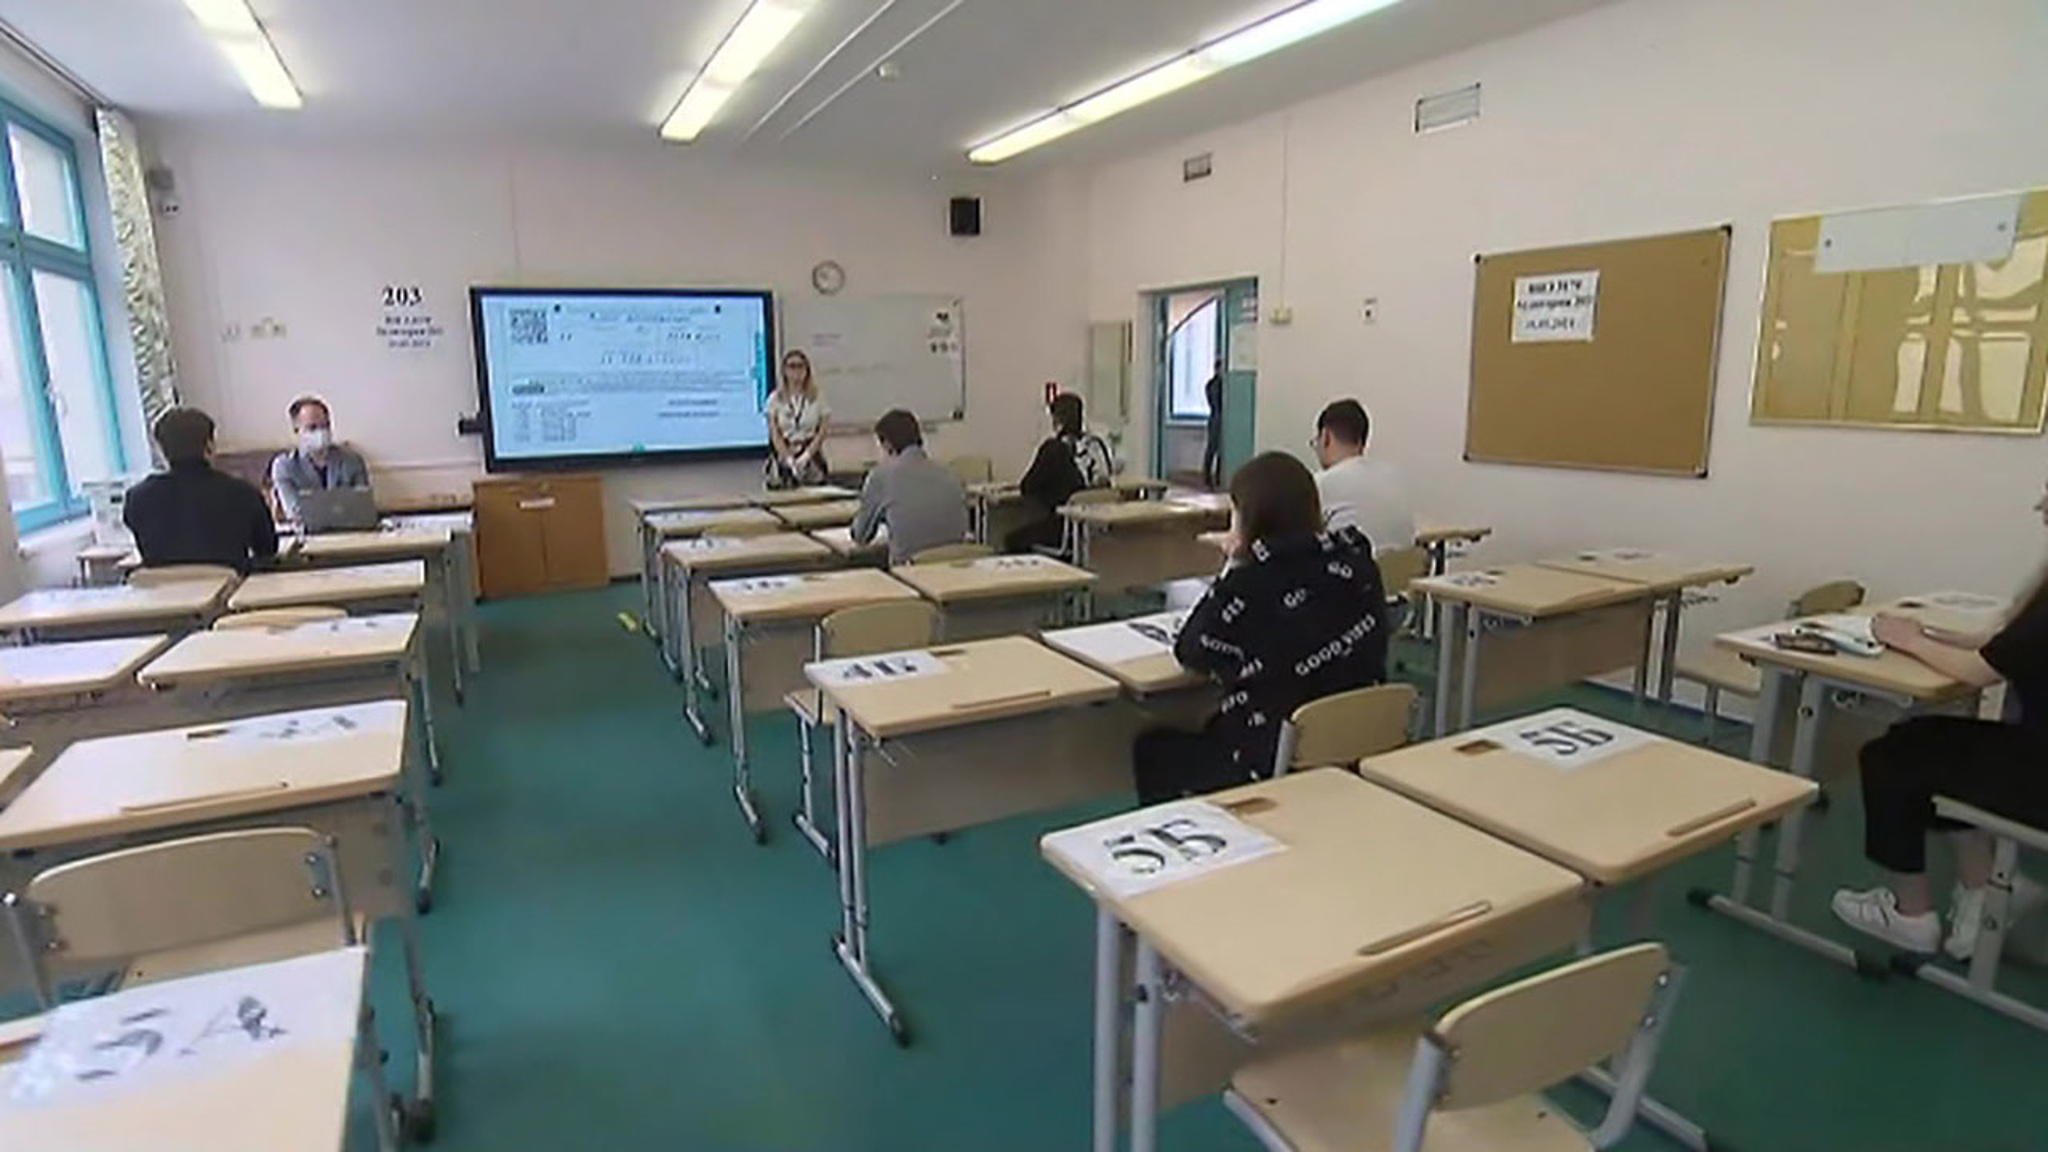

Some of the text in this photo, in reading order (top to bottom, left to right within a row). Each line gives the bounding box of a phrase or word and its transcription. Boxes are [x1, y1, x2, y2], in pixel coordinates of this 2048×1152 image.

[382, 286, 422, 306] 203
[1295, 641, 1342, 676] GOOD
[1103, 819, 1227, 875] 5Б
